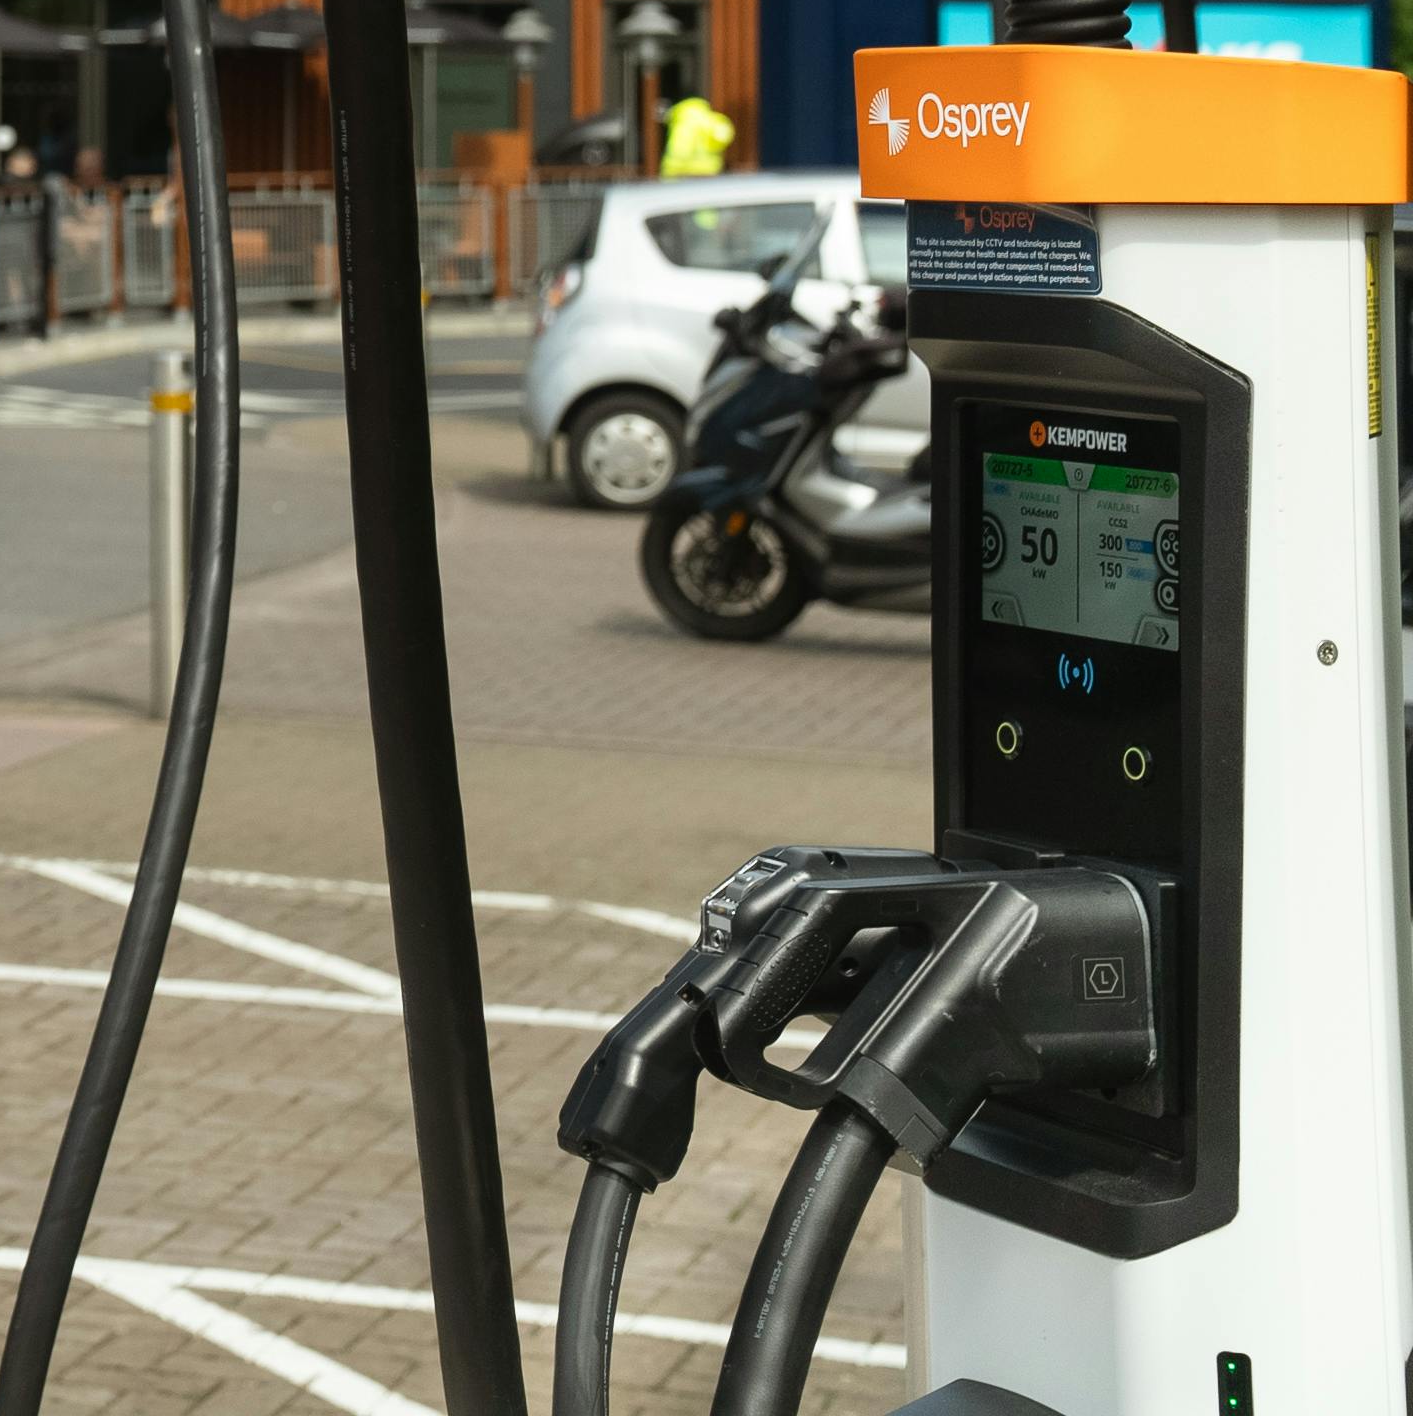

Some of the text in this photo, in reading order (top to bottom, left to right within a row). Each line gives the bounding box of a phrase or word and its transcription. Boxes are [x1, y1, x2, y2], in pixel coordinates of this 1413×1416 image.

[917, 92, 1030, 148] Osprey
[979, 205, 1035, 233] Osprey
[915, 237, 927, 246] This
[929, 238, 939, 246] site
[945, 238, 975, 246] monitored
[976, 238, 985, 248] by
[985, 238, 1003, 247] CCTV
[1003, 240, 1015, 248] and
[1016, 240, 1051, 250] technology
[1057, 240, 1081, 248] located
[934, 250, 941, 258] to
[942, 250, 965, 258] monitor
[965, 250, 975, 258] the
[977, 250, 996, 258] health
[997, 251, 1009, 259] and
[1009, 251, 1029, 259] status
[1029, 250, 1036, 259] of
[1037, 251, 1047, 260] the
[1049, 252, 1077, 262] chargers.
[1079, 252, 1091, 260] We
[918, 260, 933, 268] track
[933, 260, 943, 268] the
[944, 261, 963, 269] cables
[964, 261, 975, 270] and
[977, 262, 988, 272] any
[989, 262, 1005, 270] other
[1006, 263, 1043, 272] components
[1050, 264, 1077, 272] removed
[1078, 264, 1095, 272] from
[911, 270, 1091, 285] this charger and pursue legal action against the perpetrators.
[1048, 425, 1127, 453] KEMPOWER
[993, 460, 1034, 477] 20727-5
[1124, 474, 1171, 492] 20727-6
[1019, 491, 1061, 504] AVAILABLE
[1096, 499, 1140, 514] AVAILABLE
[1108, 517, 1128, 529] CCS2
[1020, 525, 1058, 566] 50
[1098, 533, 1123, 552] 300
[1032, 567, 1046, 579] kW
[1099, 561, 1123, 579] 150
[1104, 580, 1117, 590] kW
[1100, 970, 1109, 985] L
